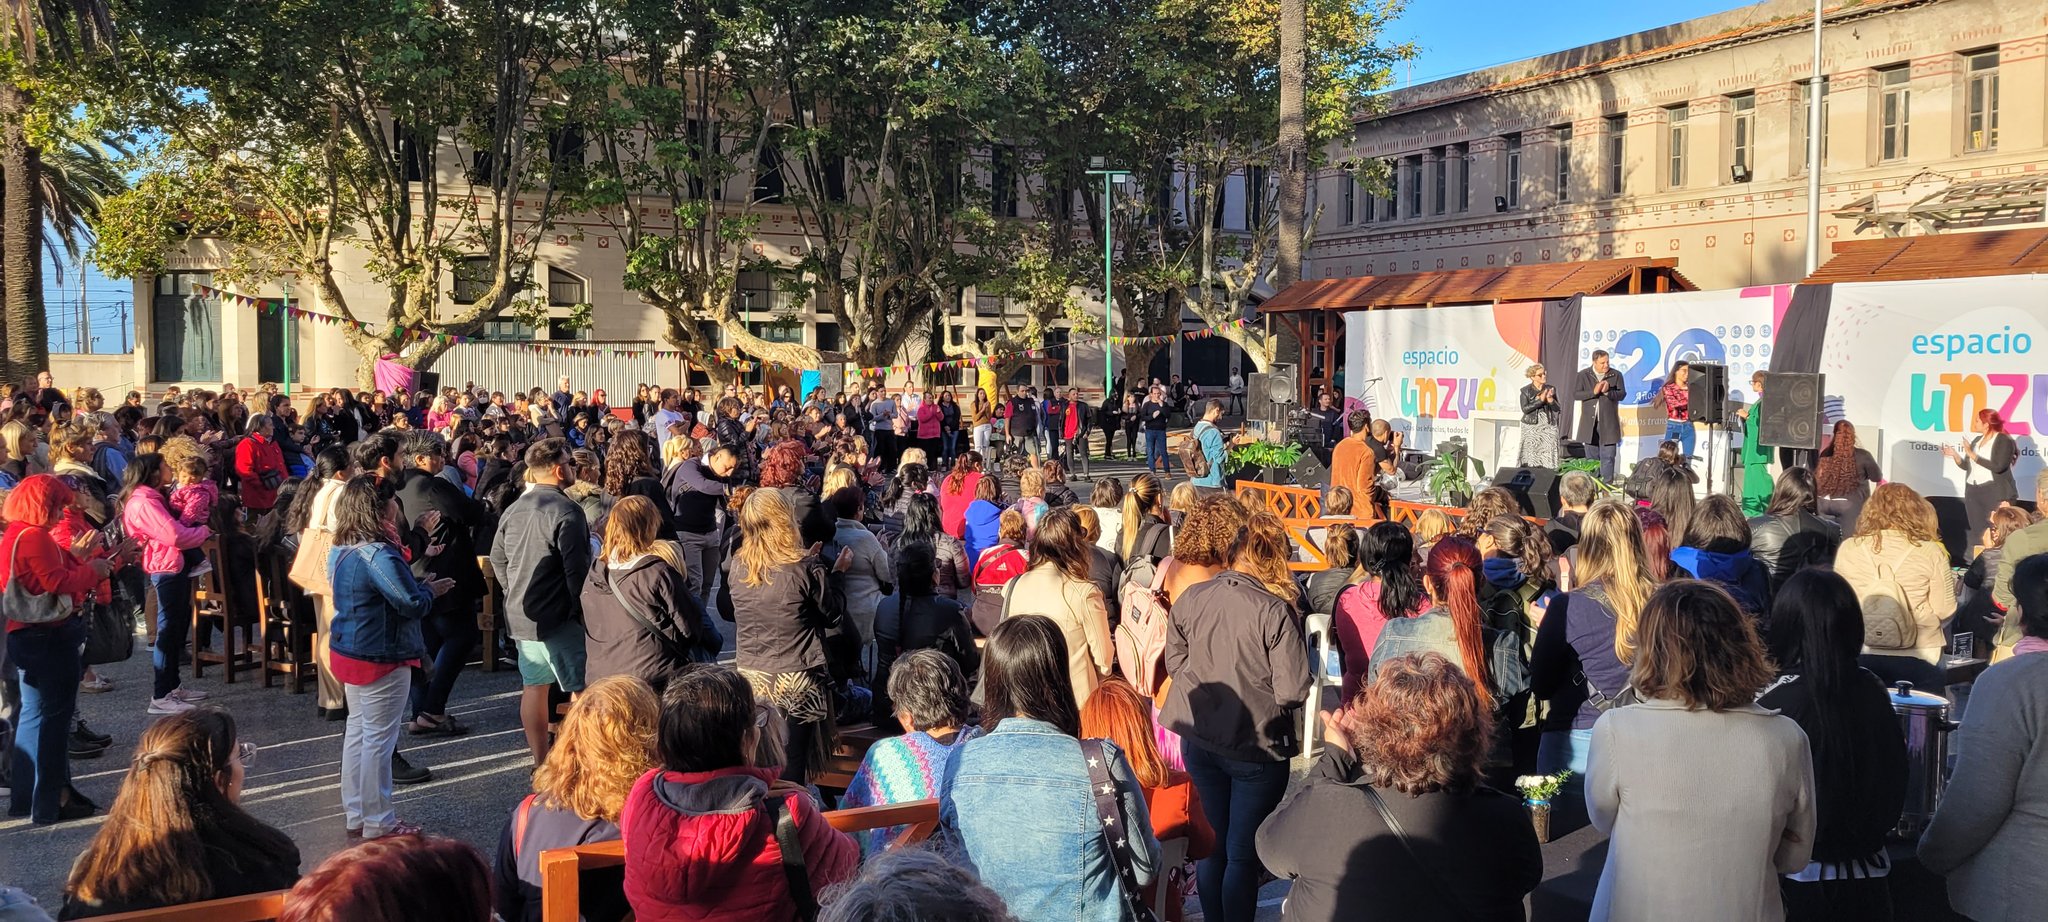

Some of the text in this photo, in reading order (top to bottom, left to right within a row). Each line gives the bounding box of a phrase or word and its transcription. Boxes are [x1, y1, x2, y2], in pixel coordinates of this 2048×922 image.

[1402, 345, 1459, 369] espacio
[1912, 325, 2032, 361] espacio
[1401, 367, 1497, 420] unzué
[1909, 441, 1939, 452] Todas
[2021, 446, 2040, 456] dos
